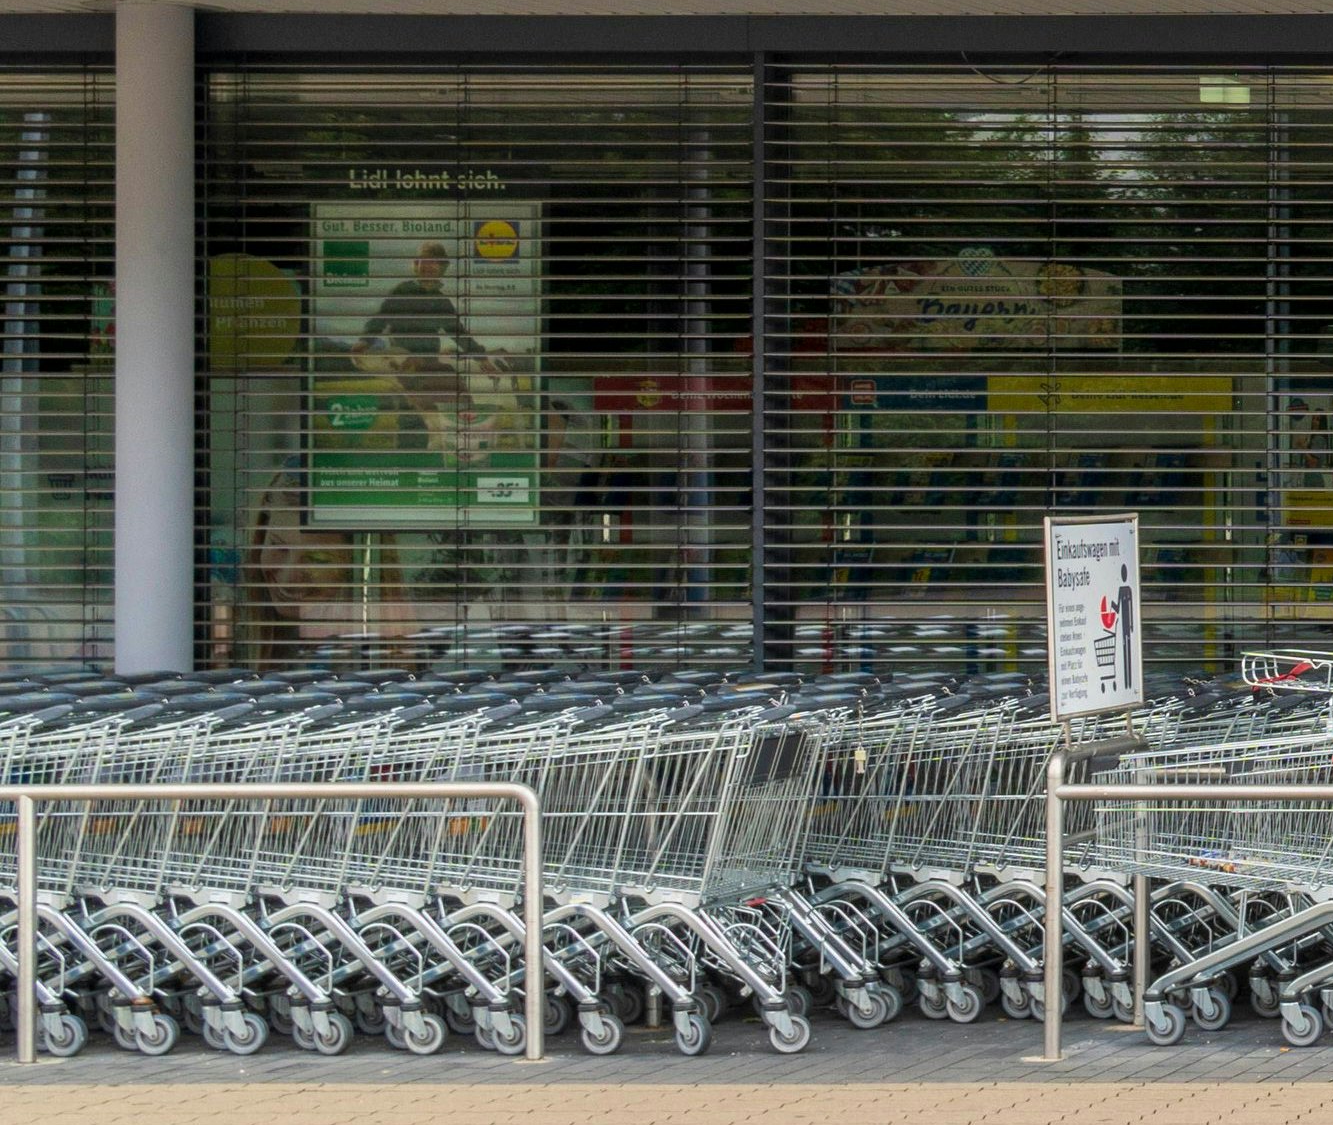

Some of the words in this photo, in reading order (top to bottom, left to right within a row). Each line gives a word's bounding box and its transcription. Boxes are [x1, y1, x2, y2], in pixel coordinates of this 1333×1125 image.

[349, 169, 387, 189] Lidl
[396, 169, 450, 189] lohnt
[457, 169, 507, 190] sich.
[322, 222, 350, 234] Gut.
[352, 221, 399, 234] Besser.
[402, 221, 456, 234] Bioland.
[1057, 539, 1107, 562] Einkaufswagen
[1109, 537, 1120, 556] mit
[1057, 566, 1091, 591] Babysafe
